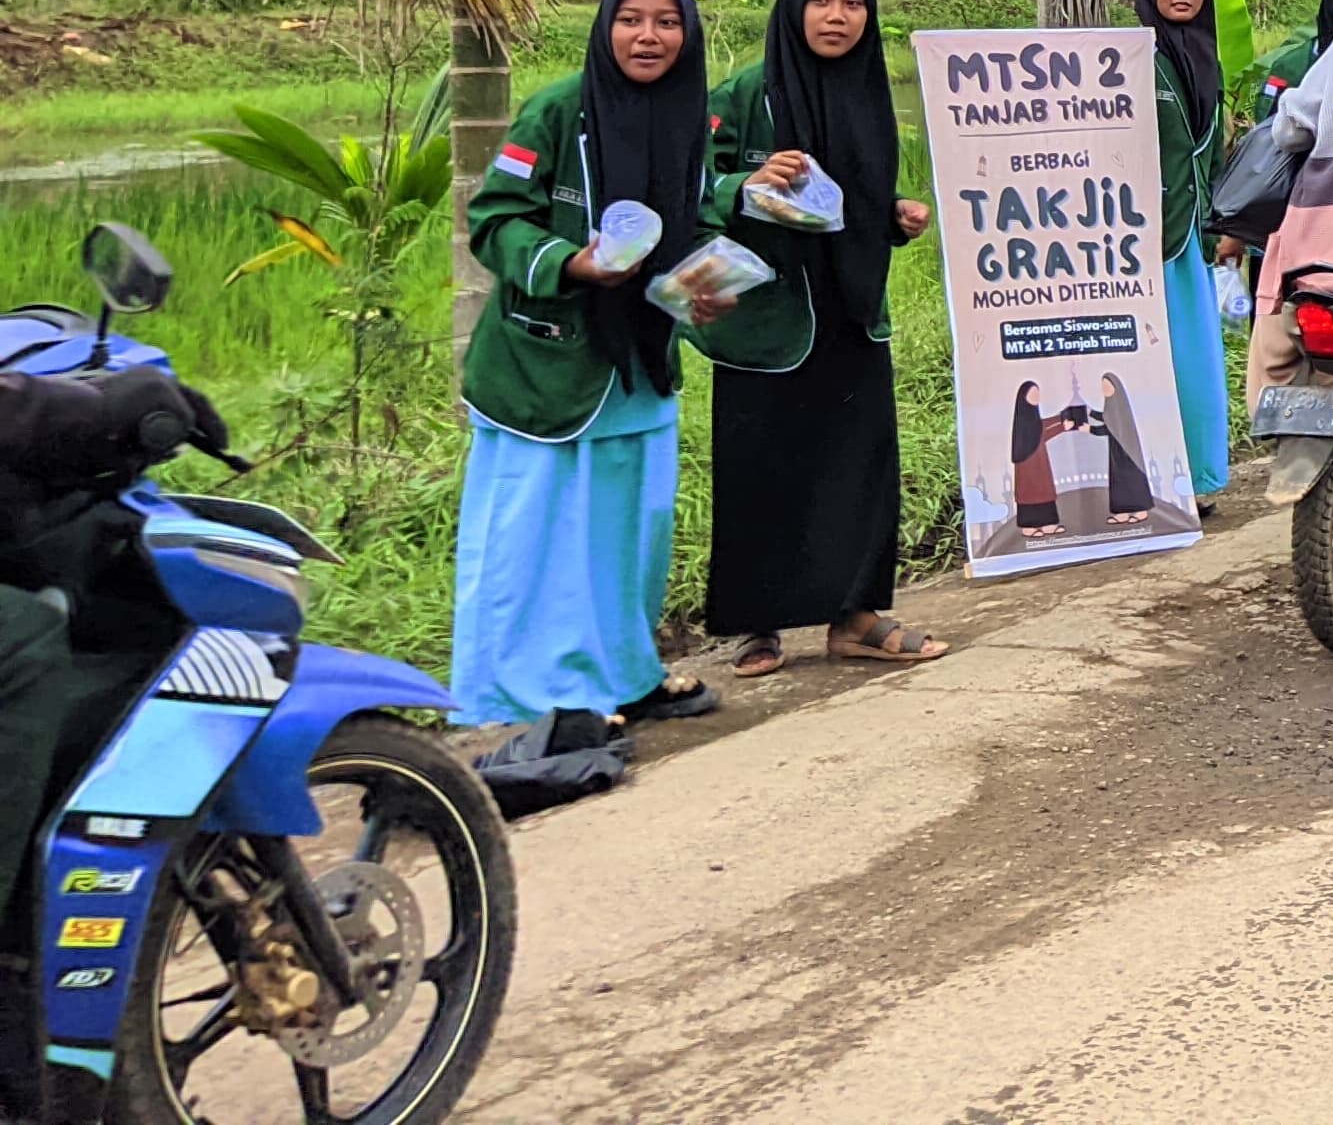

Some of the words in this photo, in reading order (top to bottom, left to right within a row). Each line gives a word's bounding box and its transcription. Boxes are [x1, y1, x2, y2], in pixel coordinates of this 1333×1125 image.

[948, 43, 1081, 93] MTSN
[1098, 47, 1125, 87] 2
[948, 98, 1049, 125] TANJAB
[1057, 94, 1134, 121] TIMUR
[1011, 150, 1090, 172] BERBAGI
[959, 176, 1146, 233] TAKJIL
[977, 233, 1142, 281] GRATIS
[973, 286, 1053, 309] MOHON
[1059, 280, 1145, 303] DITERIMA
[1003, 323, 1061, 336] Bersama
[1063, 317, 1132, 332] Siswa-siswi
[1005, 339, 1042, 354] MTsN
[1044, 338, 1055, 352] 2
[1056, 335, 1098, 352] Tanjab
[1100, 335, 1133, 348] Timur
